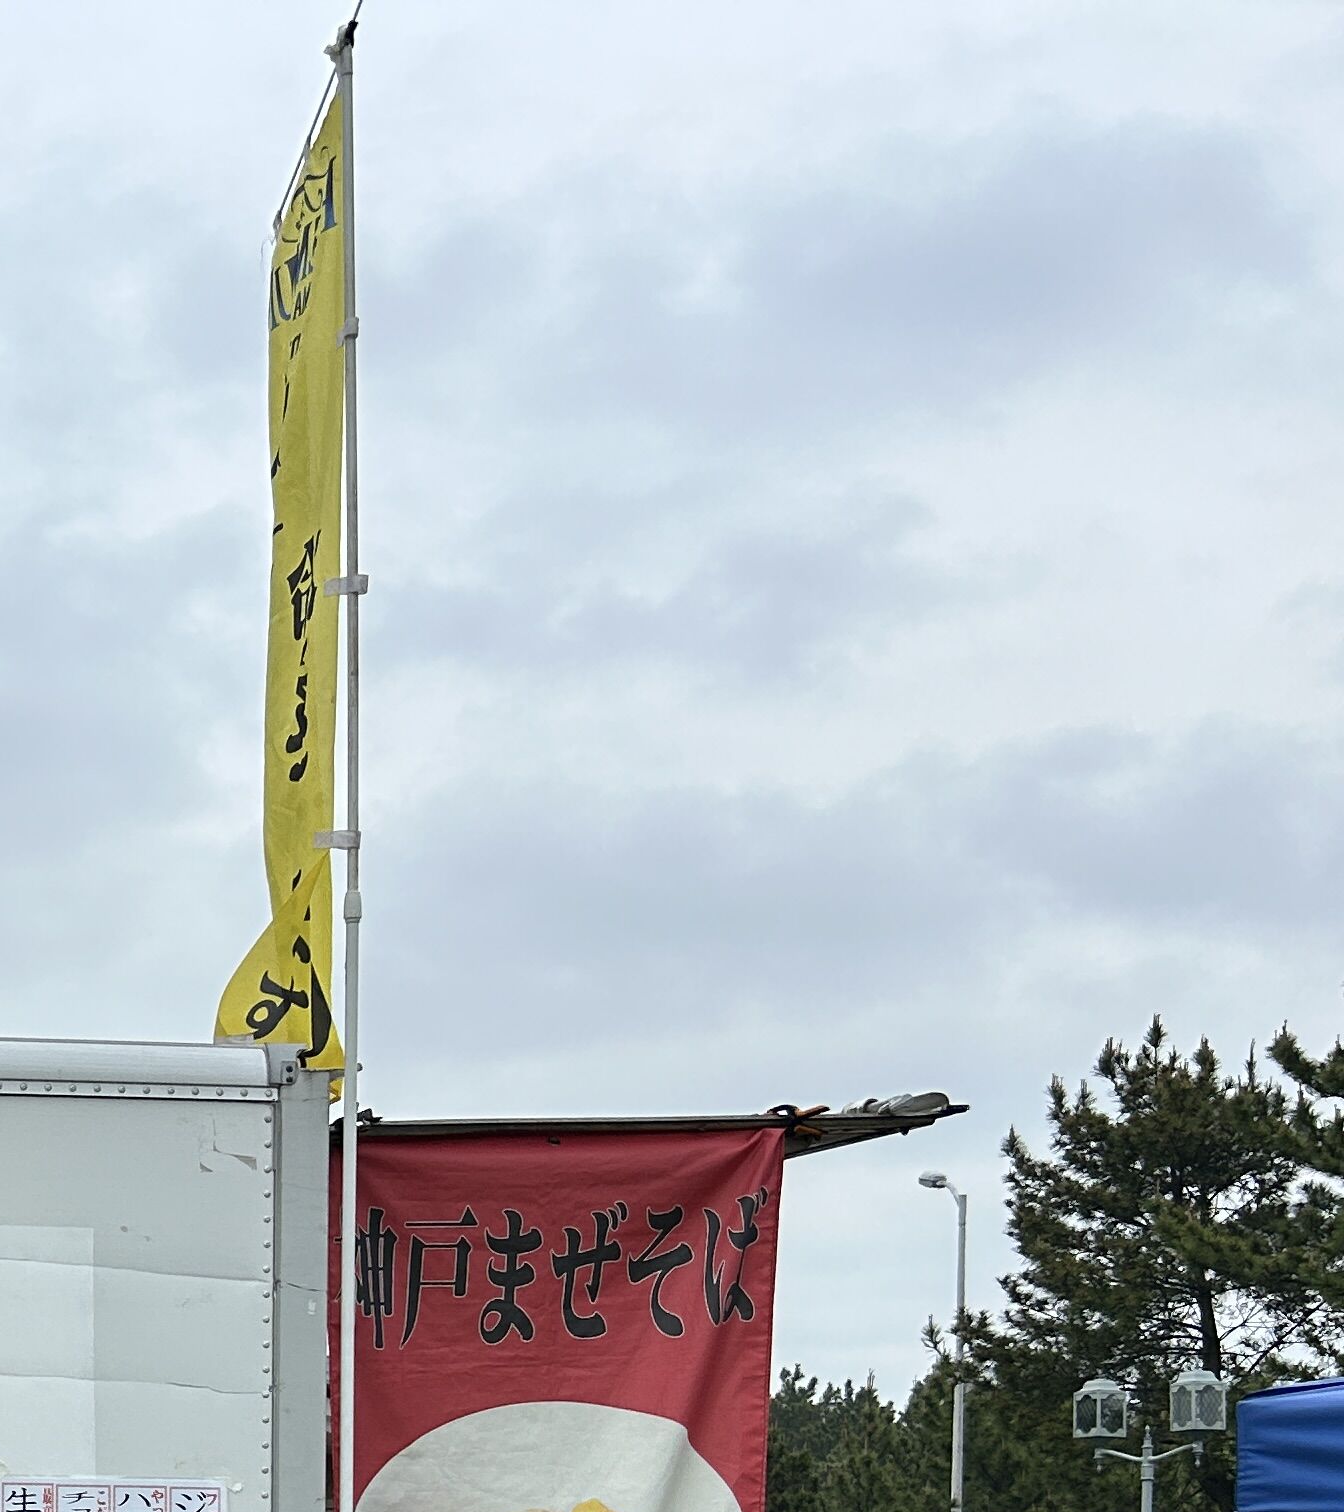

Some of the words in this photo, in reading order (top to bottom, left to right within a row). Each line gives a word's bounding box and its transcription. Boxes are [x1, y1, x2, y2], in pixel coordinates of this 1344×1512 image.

[335, 1186, 770, 1350] 神戸まぜそば
